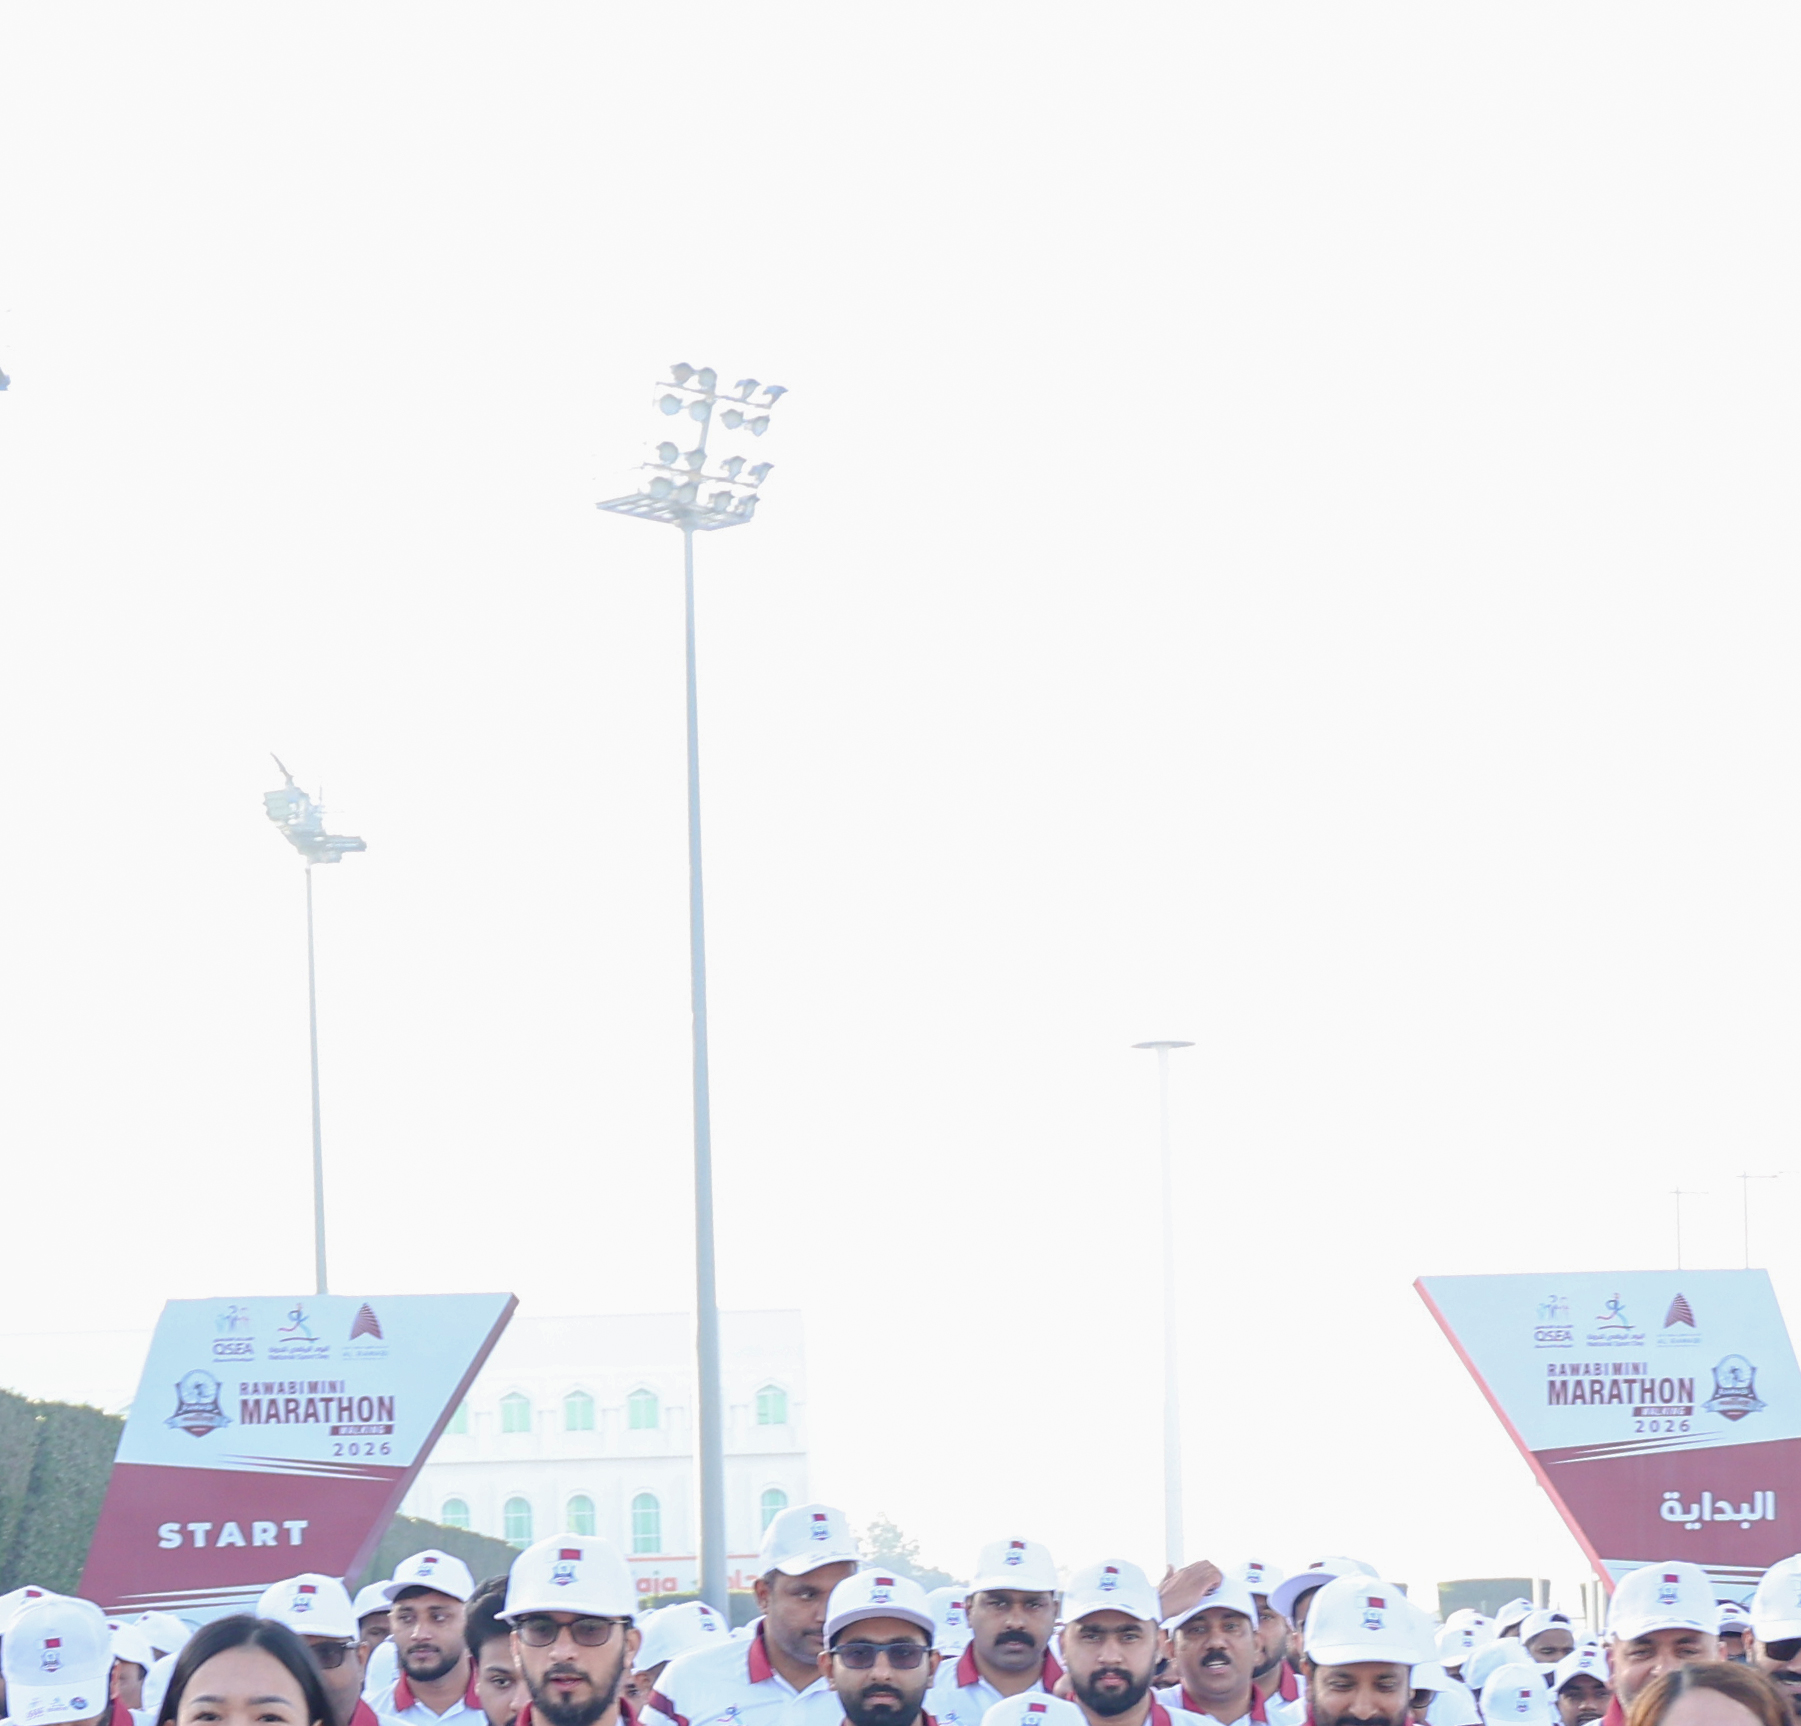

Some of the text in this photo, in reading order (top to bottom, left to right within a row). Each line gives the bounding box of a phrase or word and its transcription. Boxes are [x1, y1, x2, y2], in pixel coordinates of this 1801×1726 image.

[1547, 1377, 1694, 1405] MARATHON
[240, 1395, 395, 1425] MARATHON
[1634, 1419, 1691, 1433] 2026
[333, 1442, 392, 1457] 2026
[1659, 1491, 1776, 1530] البداية
[157, 1520, 309, 1549] START
